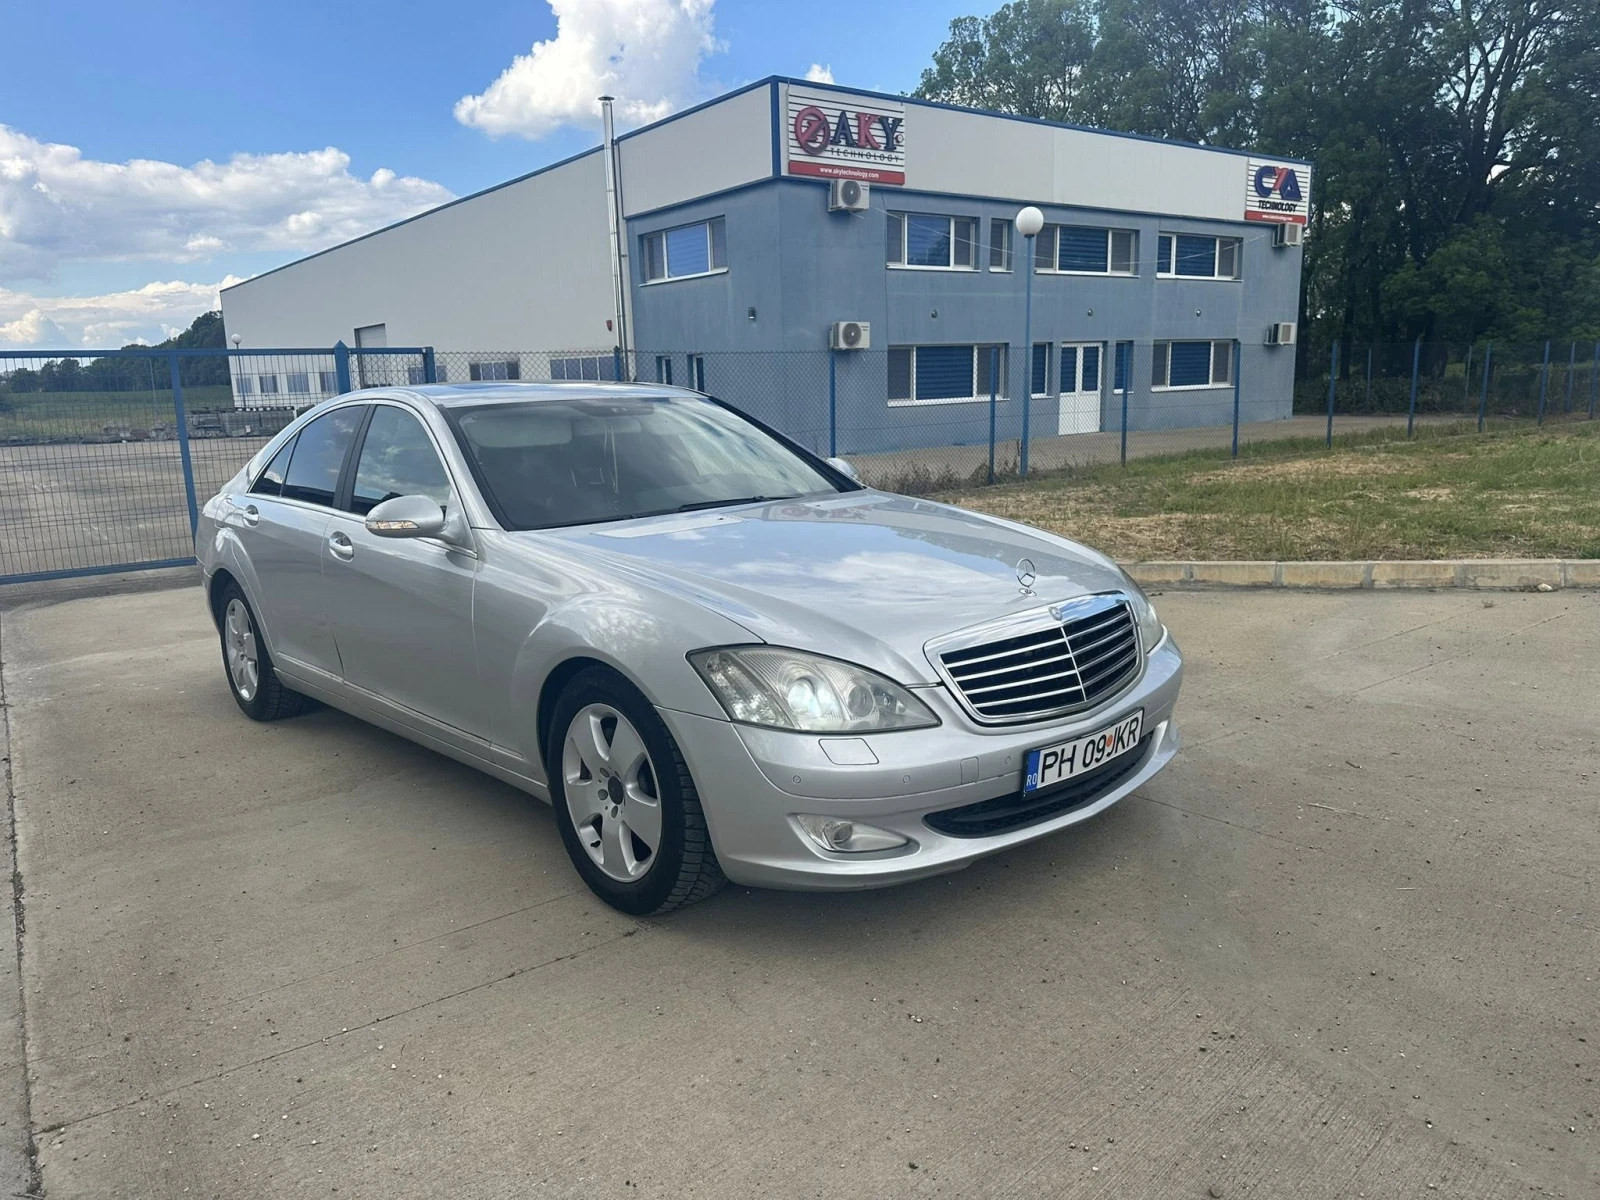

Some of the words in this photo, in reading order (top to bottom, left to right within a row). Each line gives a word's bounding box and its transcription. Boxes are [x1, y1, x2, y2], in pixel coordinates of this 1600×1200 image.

[830, 110, 903, 151] AKY
[830, 147, 900, 163] TECHNOLOGY
[820, 166, 879, 179] www.akytechnology.com
[1258, 200, 1297, 212] TECHNOLOGY
[1041, 744, 1077, 783] PH
[1082, 734, 1107, 768] 09
[1106, 716, 1139, 757] JKR
[1026, 773, 1038, 787] RO
